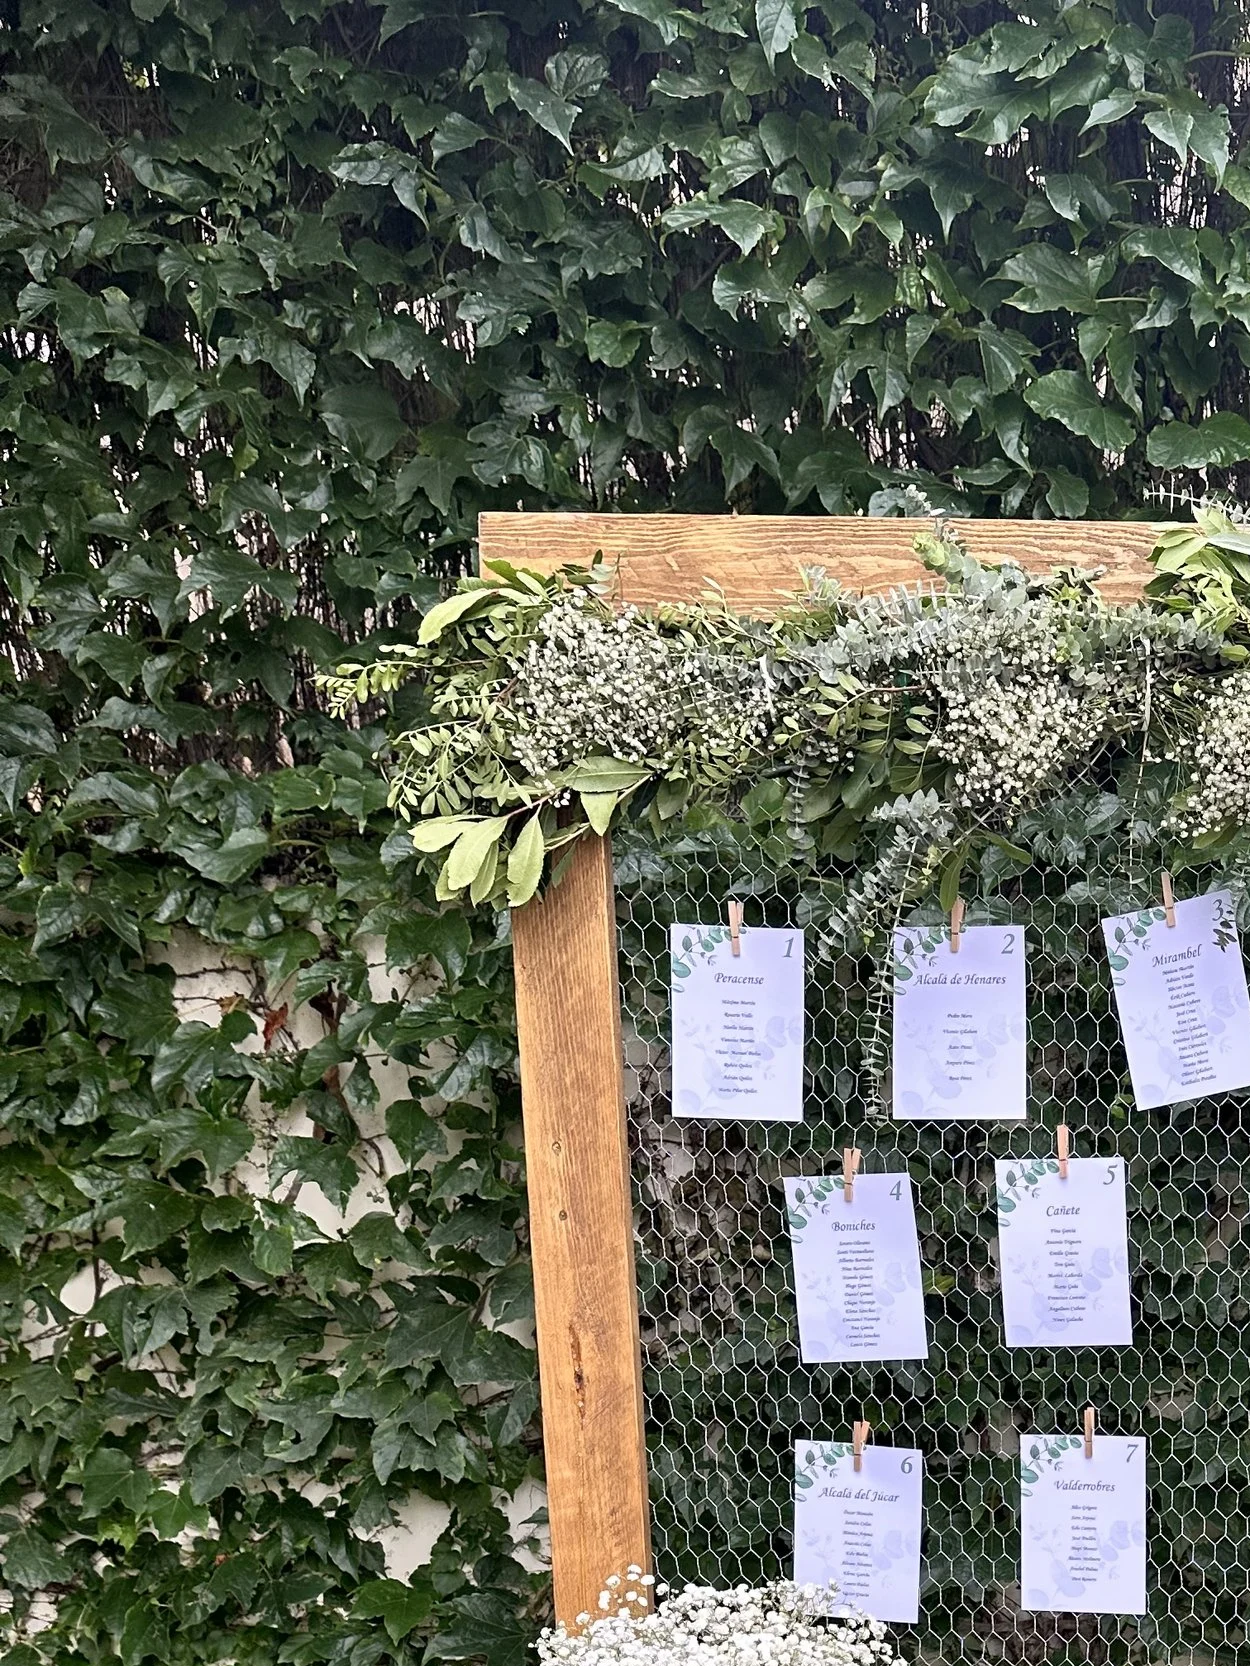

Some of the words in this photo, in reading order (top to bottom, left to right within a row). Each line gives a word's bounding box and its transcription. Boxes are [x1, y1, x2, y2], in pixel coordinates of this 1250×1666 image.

[1211, 898, 1225, 922] 3
[781, 936, 795, 958] 1
[1000, 933, 1016, 955] 2
[1151, 943, 1204, 968] Mirambel
[713, 972, 765, 985] Peracense
[912, 973, 948, 987] Alcalá
[949, 973, 962, 985] de
[964, 974, 1007, 985] Henares
[1102, 1164, 1118, 1186] 5
[889, 1180, 903, 1202] 4
[1045, 1205, 1081, 1217] Cañete
[831, 1219, 876, 1232] Boniches
[1126, 1443, 1139, 1464] 7
[900, 1455, 915, 1475] 6
[817, 1486, 853, 1499] Alcalá
[854, 1487, 870, 1501] del
[870, 1489, 900, 1503] Júcar
[1053, 1479, 1116, 1493] Valderrobres
